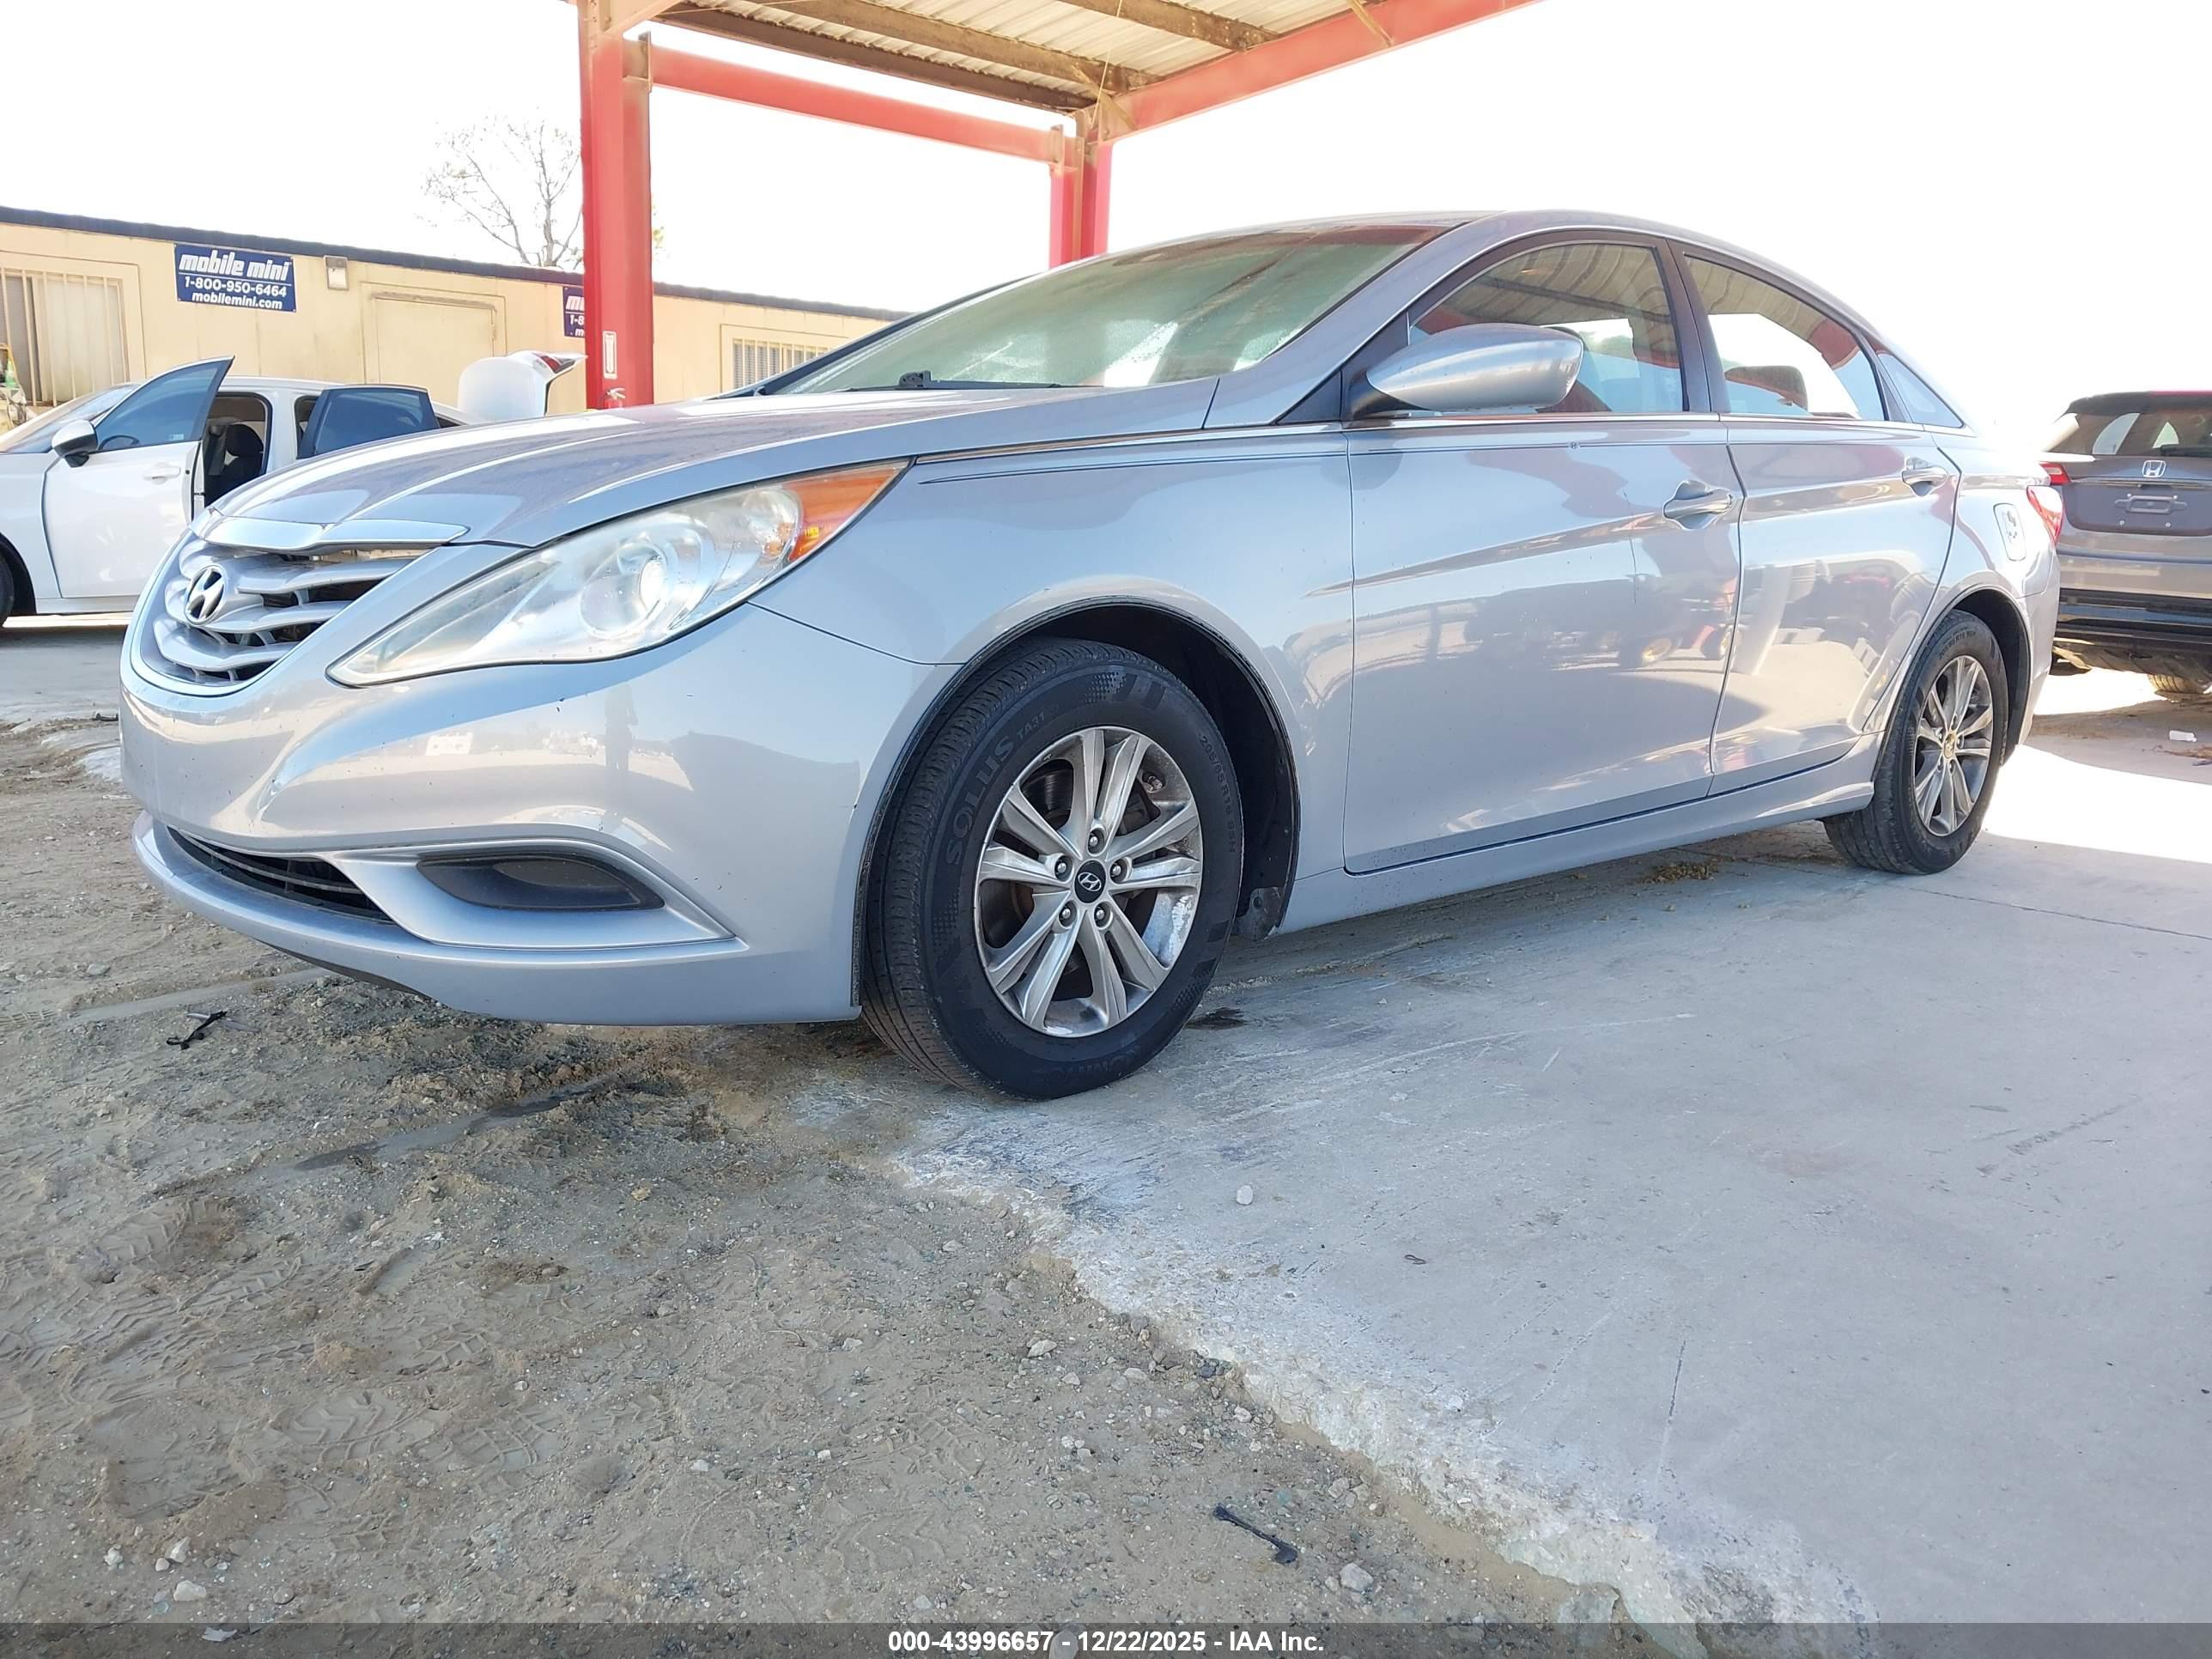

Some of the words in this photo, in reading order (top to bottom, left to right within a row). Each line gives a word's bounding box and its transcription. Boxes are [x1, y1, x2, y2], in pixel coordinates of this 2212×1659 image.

[179, 250, 245, 276] mobile
[246, 260, 289, 281] mini
[185, 276, 287, 298] 1-800-950-6464
[191, 292, 283, 309] mobilemini.com
[946, 735, 1014, 866] SOLUS
